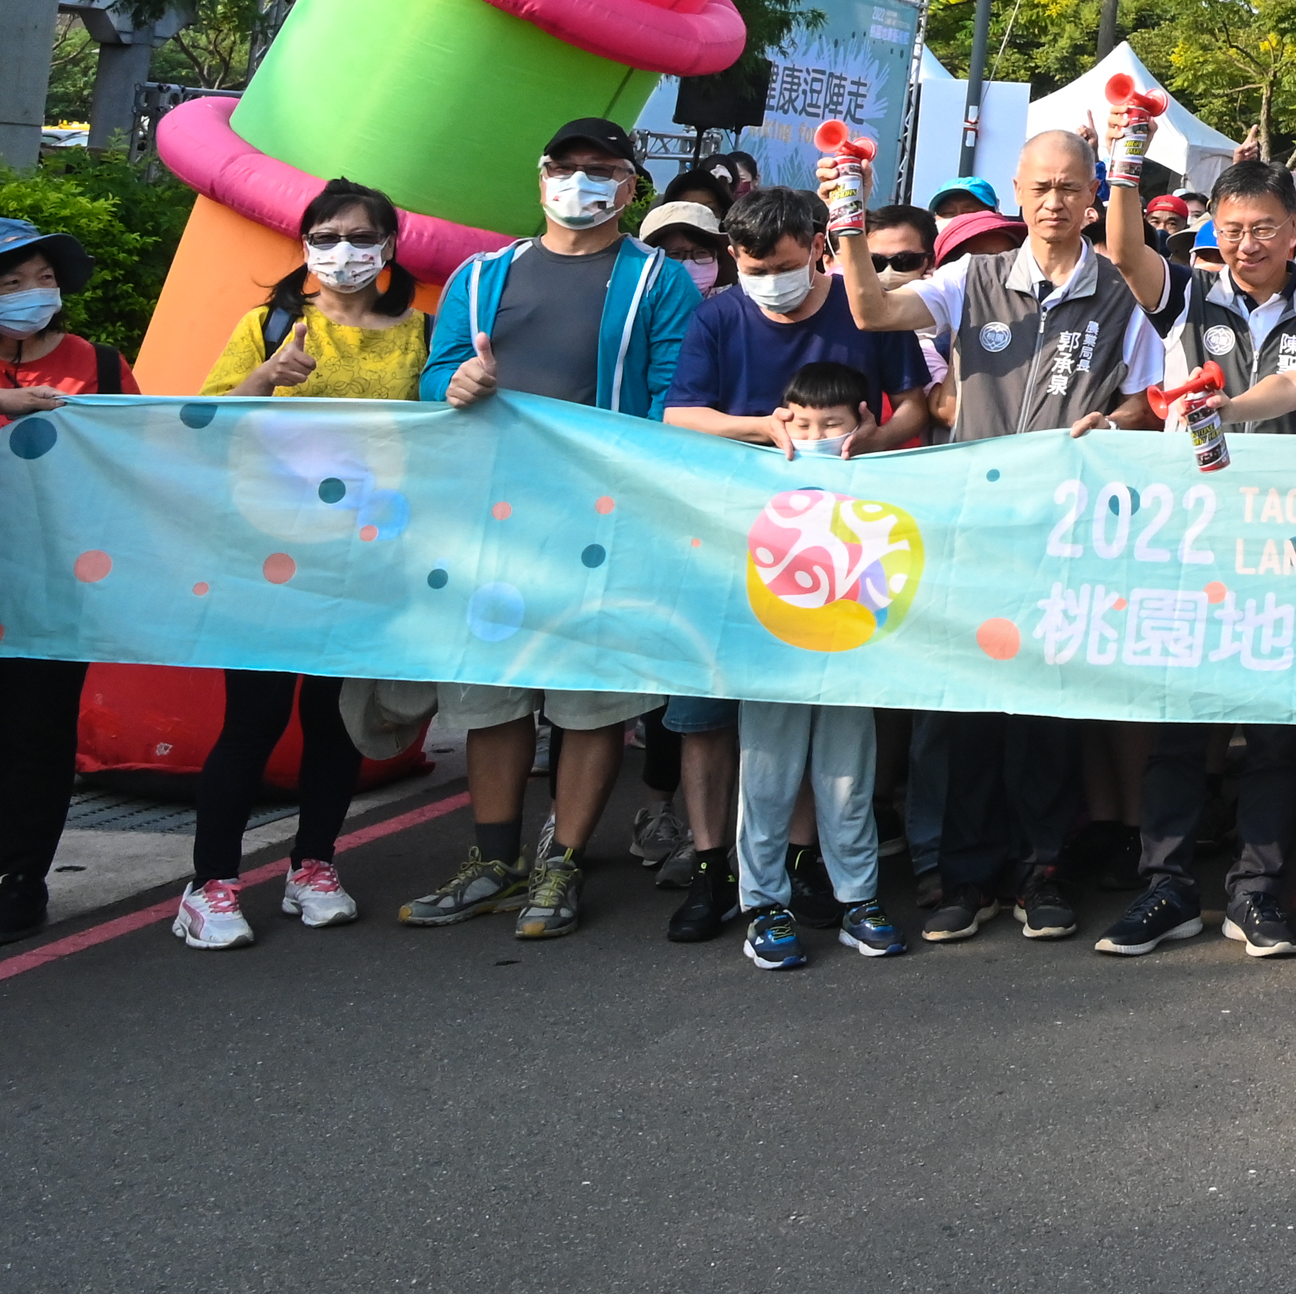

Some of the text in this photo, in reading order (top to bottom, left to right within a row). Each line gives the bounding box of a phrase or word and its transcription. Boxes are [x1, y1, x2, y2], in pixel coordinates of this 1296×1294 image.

[1046, 331, 1082, 396] 郭承泉
[1046, 479, 1218, 565] 2022
